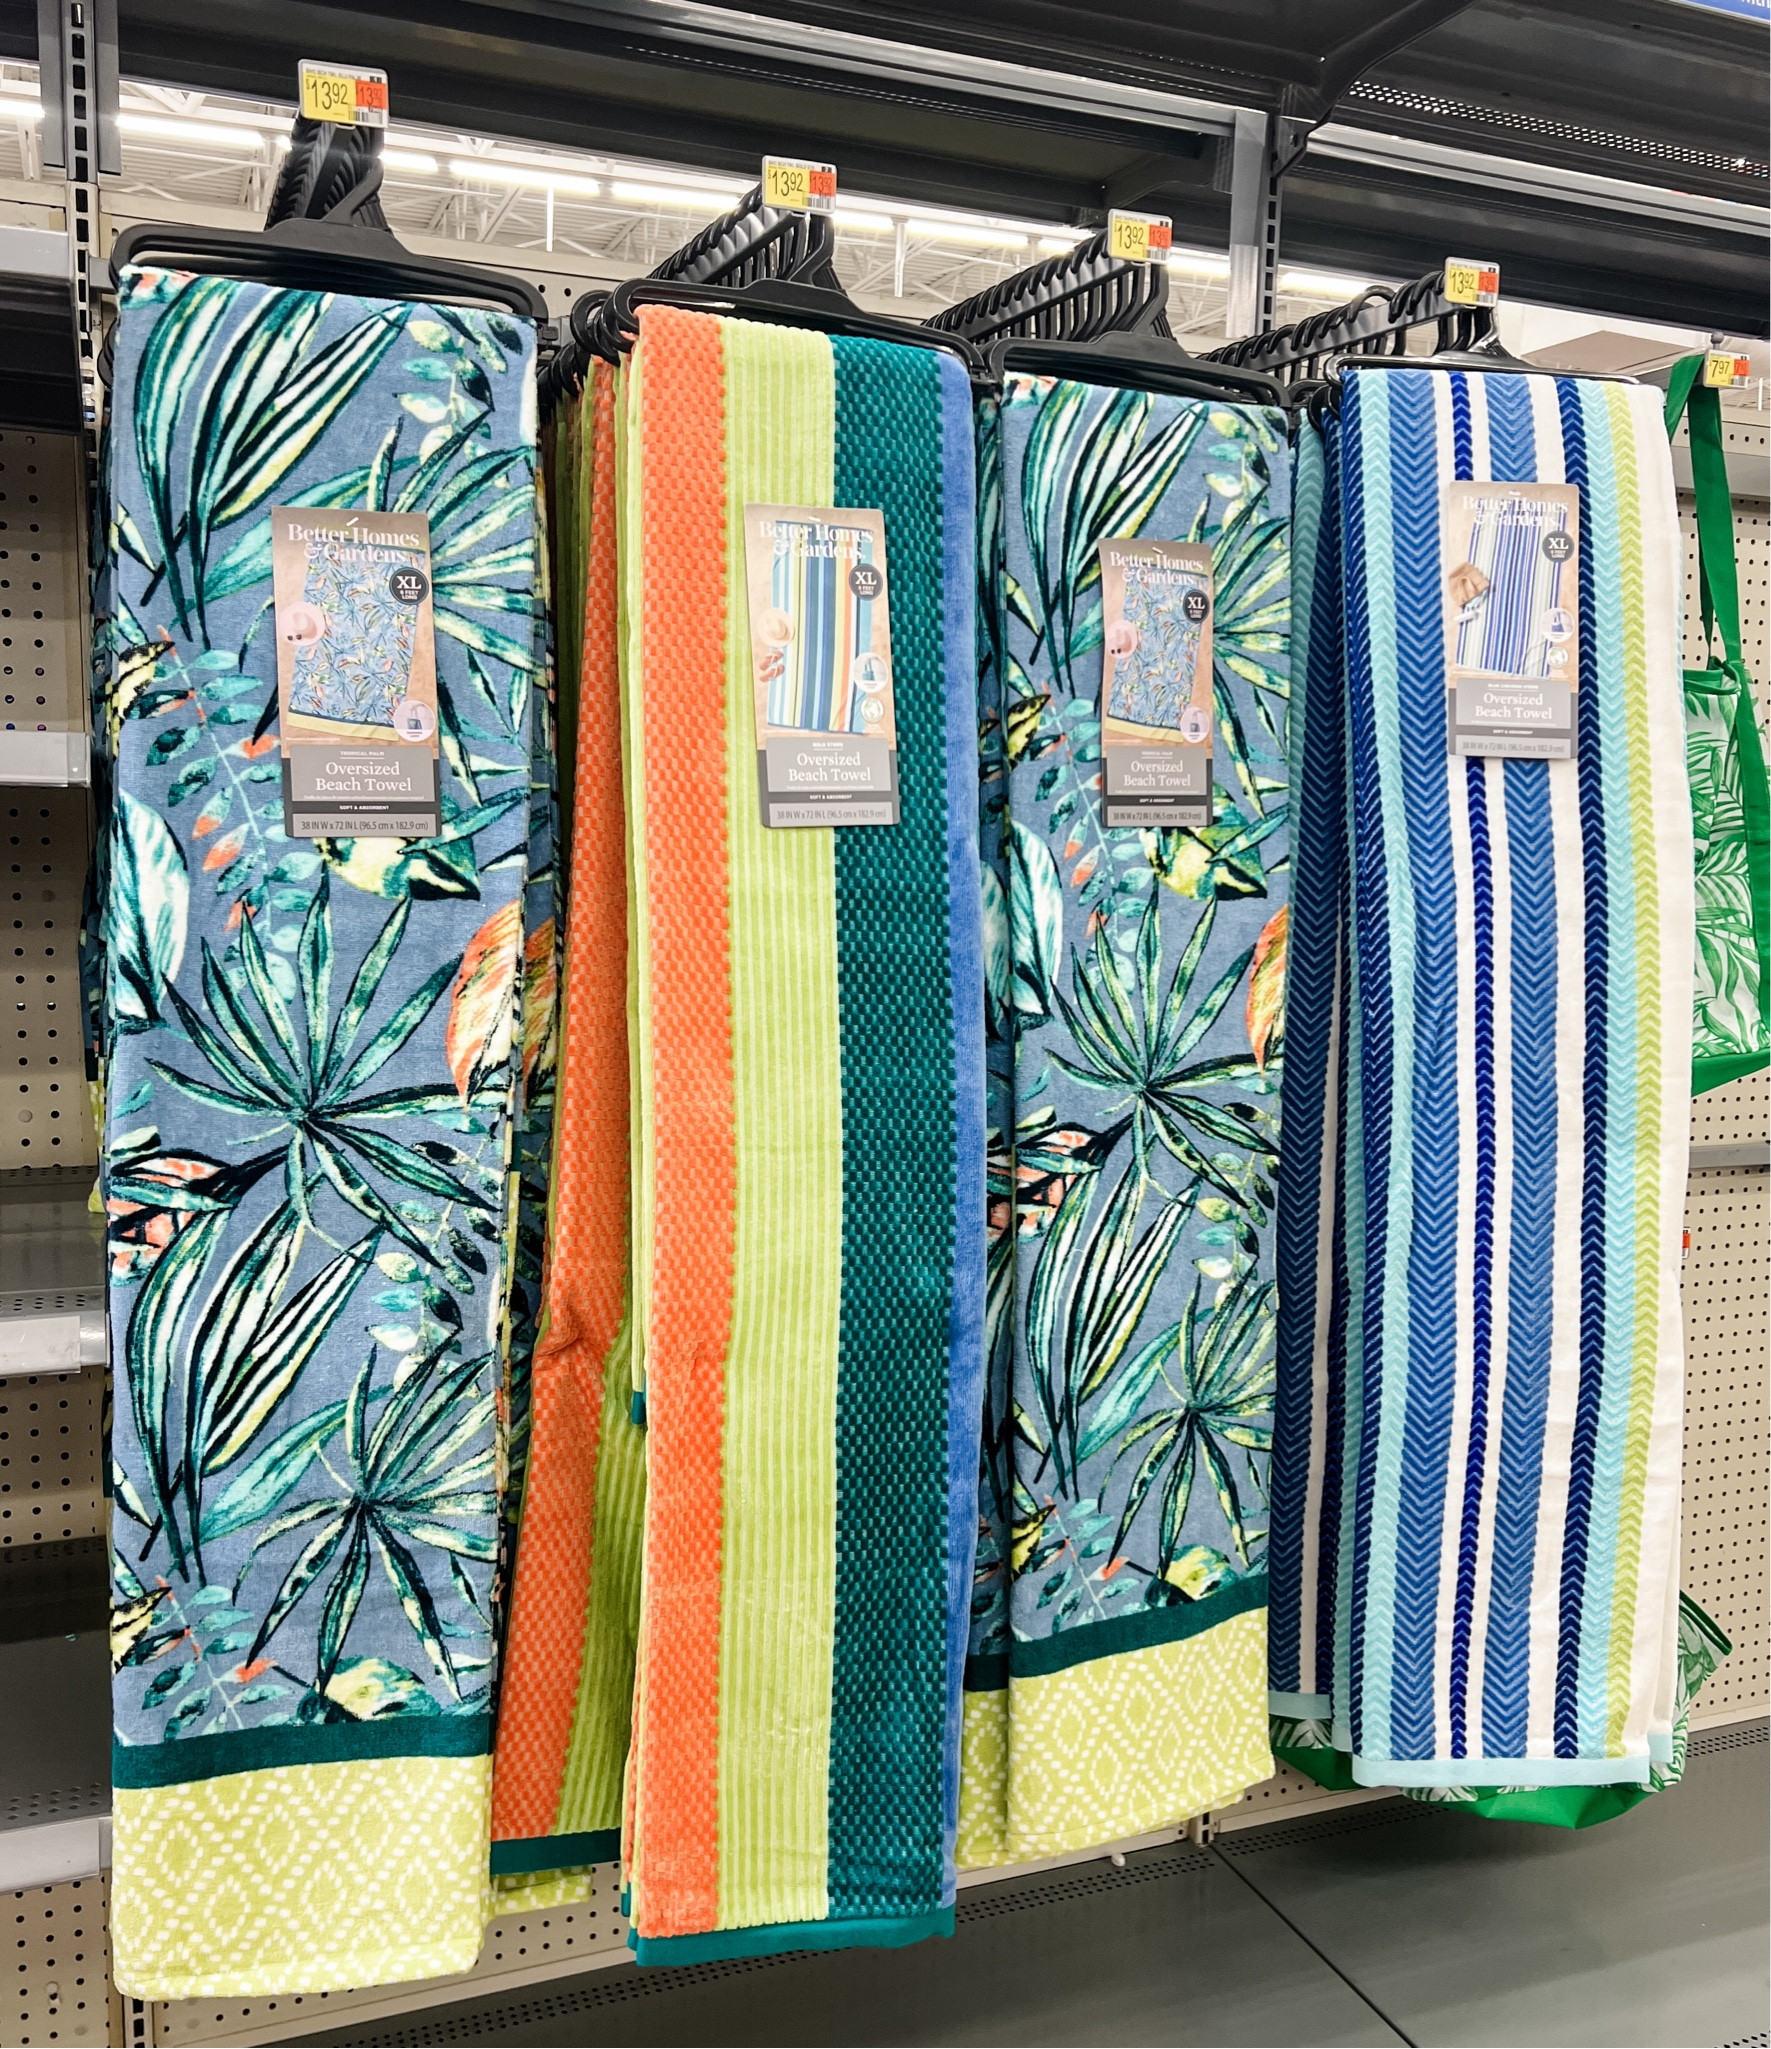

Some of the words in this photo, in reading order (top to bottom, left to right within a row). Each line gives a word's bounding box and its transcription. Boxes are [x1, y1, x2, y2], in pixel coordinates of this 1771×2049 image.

[1463, 495, 1512, 511] Better
[1514, 496, 1568, 513] Homes
[1474, 510, 1487, 525] &
[288, 523, 350, 543] Better
[352, 527, 420, 547] Homes
[759, 520, 812, 541] Better
[815, 524, 874, 543] Homes
[303, 543, 323, 559] &
[773, 539, 789, 556] &
[1547, 537, 1569, 550] XL
[1109, 551, 1154, 567] Better
[1156, 554, 1204, 571] Homes
[396, 575, 422, 590] XL
[854, 571, 877, 586] XL
[1122, 568, 1135, 582] &
[1187, 596, 1206, 610] XL
[1483, 692, 1544, 706] Oversized
[1475, 705, 1511, 718] Beach
[1514, 707, 1552, 719] Towel
[796, 751, 861, 766] Oversized
[1131, 760, 1183, 772] Oversized
[326, 761, 400, 775] Oversized
[788, 767, 828, 781] Beach
[830, 766, 871, 781] Towel
[315, 777, 361, 791] Beach
[364, 777, 412, 791] Towel
[1124, 774, 1156, 786] Beach
[1158, 774, 1191, 786] Towel
[301, 821, 311, 830] 38
[311, 821, 320, 830] IN
[320, 821, 329, 830] W
[335, 821, 343, 830] 72
[345, 821, 353, 830] IN
[353, 821, 358, 830] L
[359, 821, 377, 831] (96.5
[395, 821, 414, 830] 182.9
[415, 821, 429, 831] cm)
